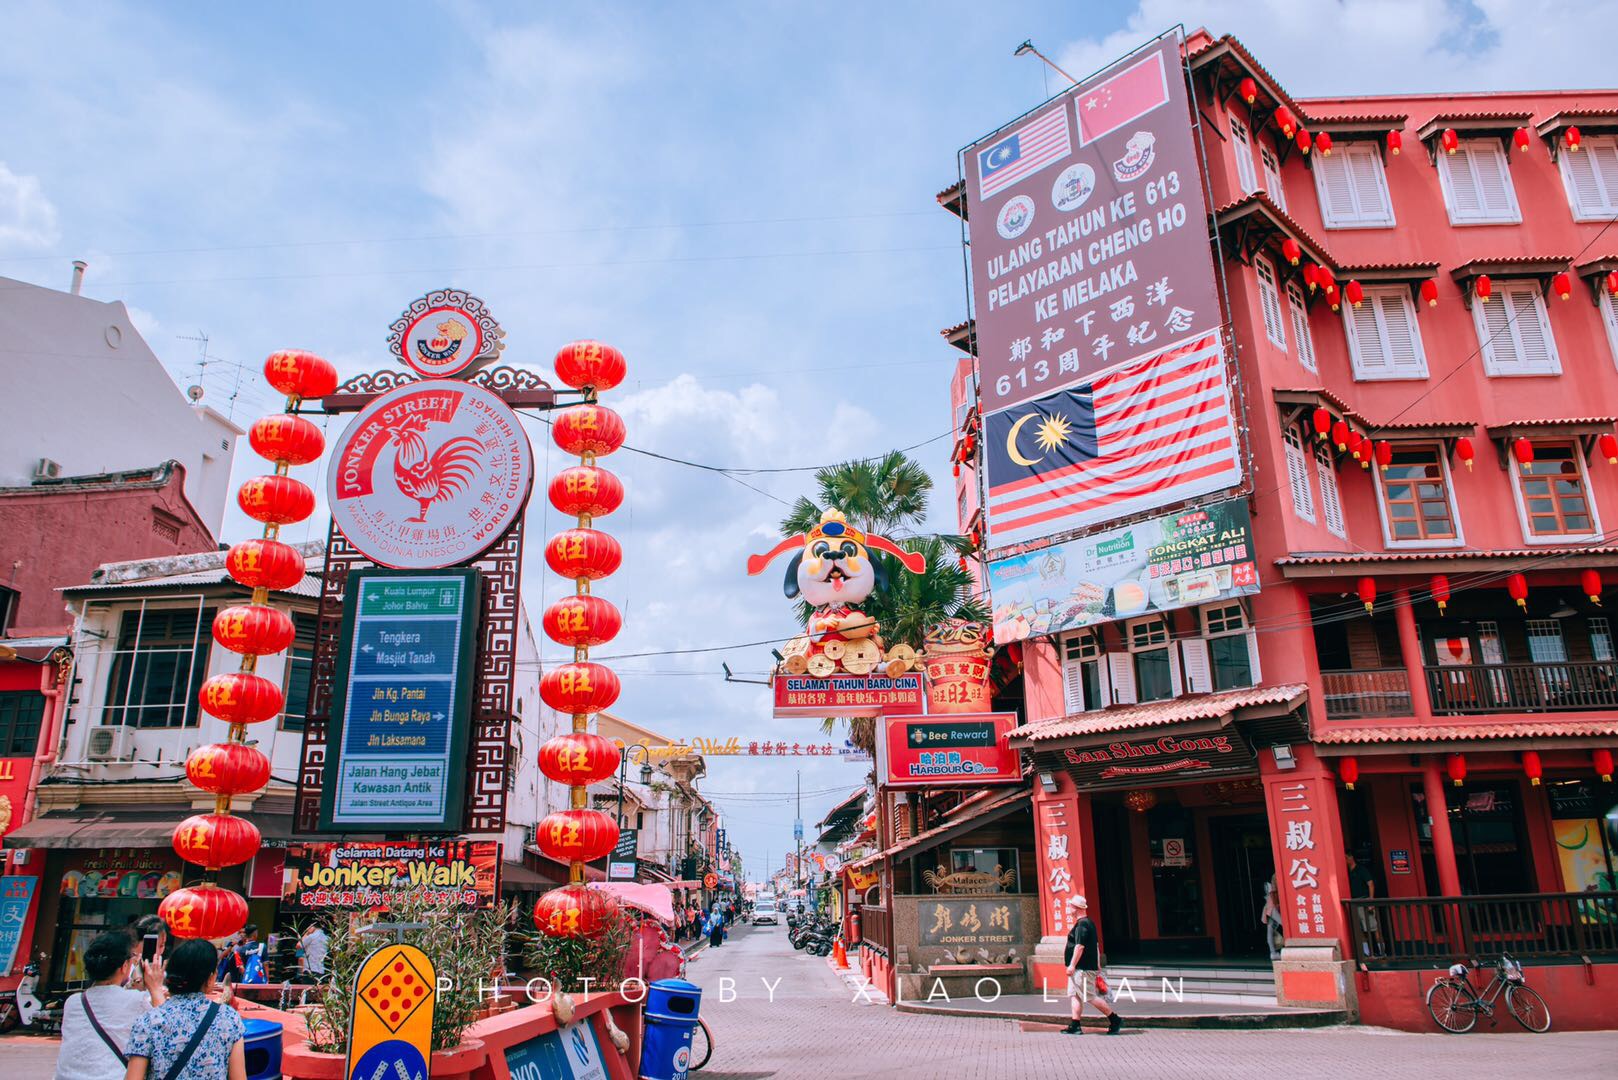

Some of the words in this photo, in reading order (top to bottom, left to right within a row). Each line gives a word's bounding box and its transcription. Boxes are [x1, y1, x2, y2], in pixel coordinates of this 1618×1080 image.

[988, 236, 1042, 279] ULANG
[1046, 205, 1106, 254] TAHUN
[1110, 191, 1137, 222] KE
[1145, 171, 1180, 205] 613
[989, 250, 1084, 311] PELAYARAN
[1088, 218, 1152, 264] CHENG
[1158, 203, 1186, 235] HO
[1035, 295, 1059, 323] KE
[1063, 260, 1138, 311] MELAKA
[273, 351, 299, 373] 旺
[574, 342, 603, 364] 旺
[470, 397, 513, 438] HERITAGE
[569, 409, 598, 431] 旺
[256, 421, 283, 440] 旺
[345, 421, 384, 491] JONKER
[382, 396, 451, 424] STREET
[507, 439, 521, 499] CULTURAL
[242, 480, 269, 506] 旺
[566, 470, 598, 494] 旺
[347, 504, 380, 544] WARISAN
[379, 540, 413, 558] DUNIA
[416, 541, 466, 558] UNESCO
[473, 503, 509, 541] WORLD
[557, 536, 588, 561] 旺
[1098, 541, 1131, 553] Nutrition
[1148, 534, 1217, 557] TONGKAT
[1220, 527, 1246, 541] ALI
[234, 548, 262, 572] 旺
[384, 586, 405, 596] Kuala
[408, 586, 436, 597] Lumpur
[383, 601, 404, 610] Johor
[406, 601, 428, 610] Bahru
[220, 613, 247, 639] 旺
[558, 606, 589, 633] 旺
[379, 631, 420, 646] Tengkera
[376, 651, 406, 667] Masjid
[408, 651, 435, 664] Tanah
[560, 667, 593, 695] 旺
[788, 679, 830, 690] SELAMAT
[833, 679, 864, 690] TAHUN
[867, 679, 893, 690] BARU
[895, 678, 918, 689] CINA
[207, 682, 236, 707] 旺
[372, 688, 384, 700] Jln
[386, 689, 399, 703] Kg.
[401, 687, 427, 700] Pantai
[370, 709, 382, 722] Jln
[384, 709, 409, 724] Bunga
[411, 709, 431, 724] Raya
[368, 735, 379, 746] Jln
[382, 734, 426, 746] Laksamana
[692, 736, 739, 755] Walk
[928, 731, 948, 740] Bee
[951, 730, 988, 740] Reward
[557, 745, 593, 773] 旺
[920, 751, 961, 765] 哈泊购
[1064, 747, 1112, 764] San
[1110, 742, 1159, 759] Shu
[1157, 736, 1232, 753] Gong
[190, 753, 216, 779] 旺
[349, 766, 377, 777] Jalan
[380, 766, 408, 780] Hang
[411, 765, 441, 777] Jebat
[353, 782, 401, 793] Kawasan
[403, 782, 432, 793] Antik
[350, 799, 368, 807] Jalan
[369, 799, 390, 807] Street
[390, 799, 416, 808] Antique
[417, 799, 433, 807] Area
[180, 826, 209, 850] 旺
[550, 821, 582, 847] 旺
[1281, 783, 1318, 889] 三叔公
[336, 847, 382, 859] Selamat
[385, 847, 425, 859] Datang
[429, 847, 445, 857] Ke
[1045, 803, 1072, 892] 三叔公
[303, 861, 397, 887] Jonker
[407, 860, 477, 887] Walk
[165, 903, 195, 931] 旺
[549, 908, 580, 935] 旺
[979, 935, 1014, 943] STREET
